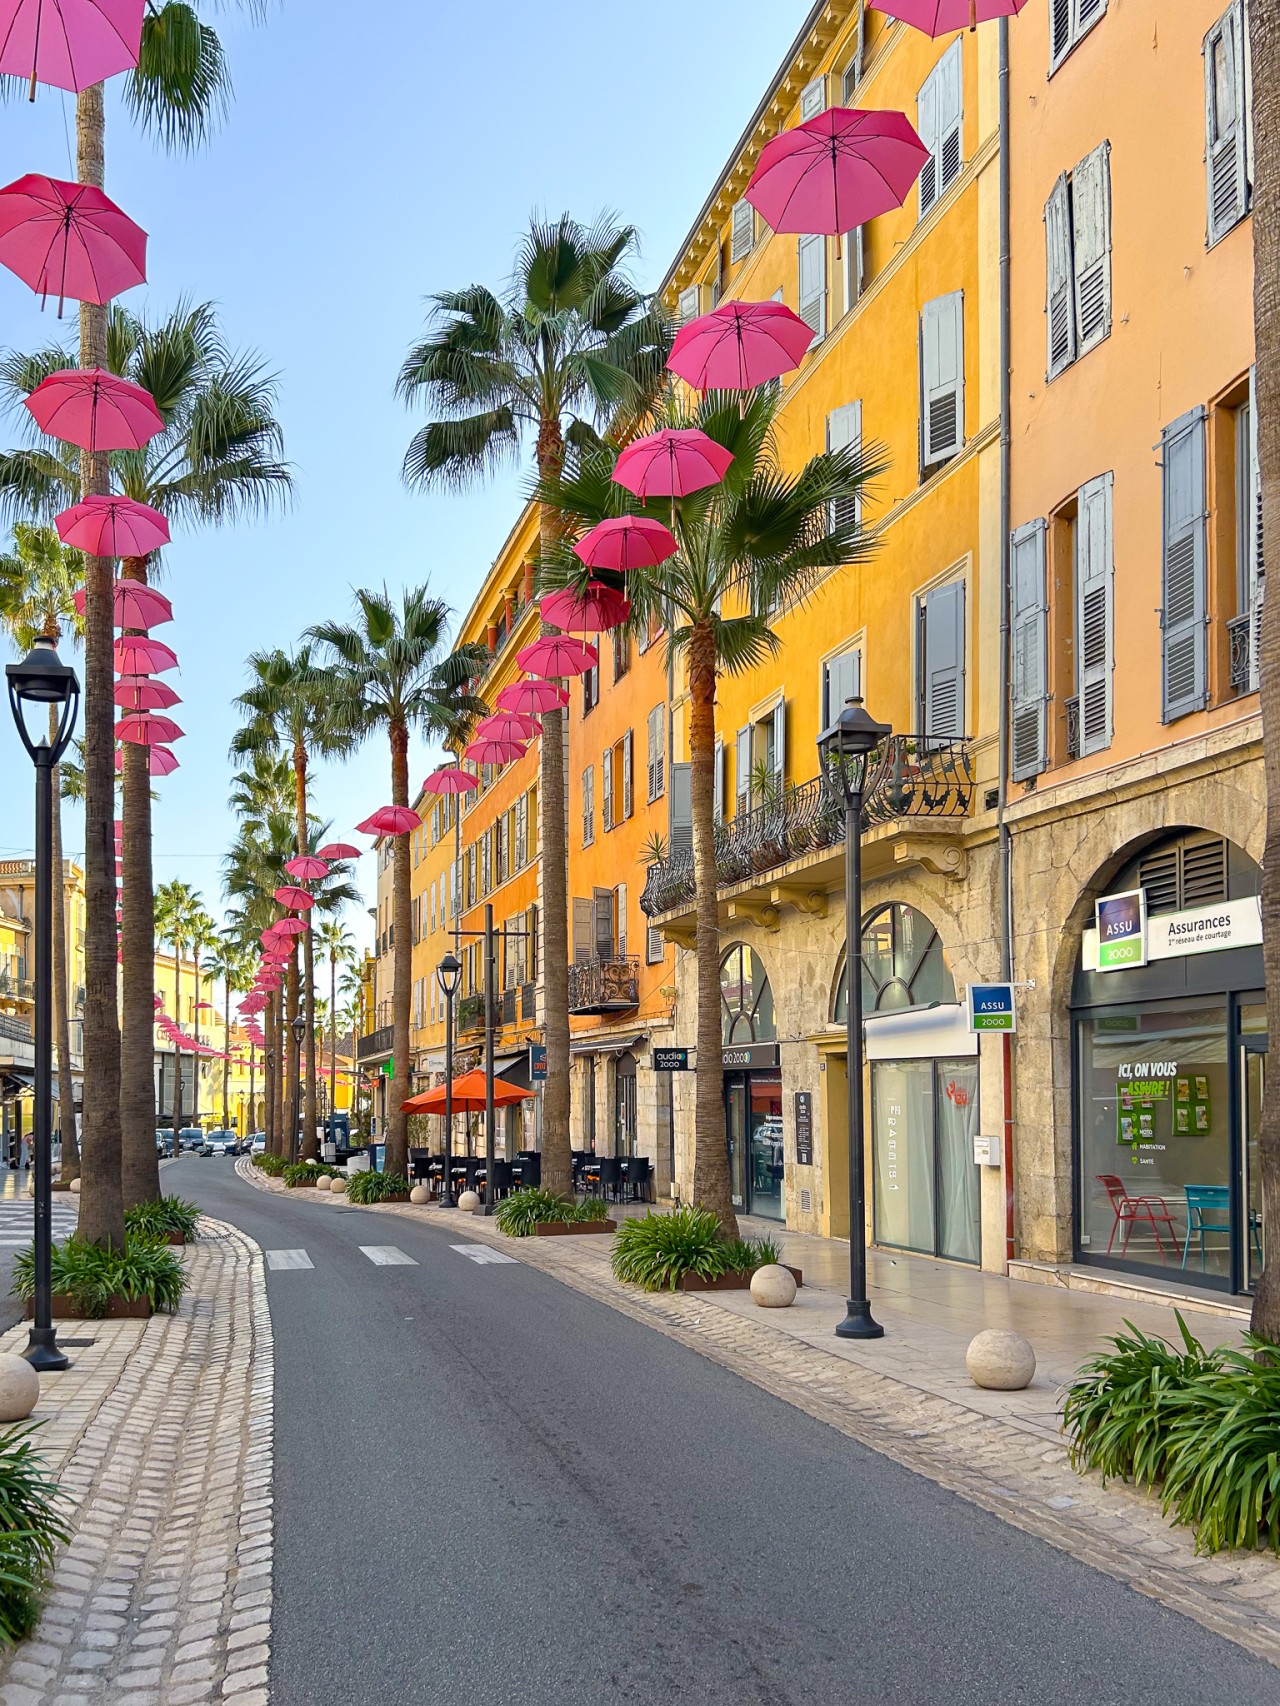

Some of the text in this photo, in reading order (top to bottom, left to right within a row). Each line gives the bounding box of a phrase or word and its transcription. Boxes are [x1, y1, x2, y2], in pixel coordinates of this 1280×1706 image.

[1106, 920, 1133, 936] ASSU
[1168, 915, 1231, 936] Assurances
[1175, 936, 1195, 945] réseau
[1196, 933, 1204, 942] de
[1205, 930, 1232, 941] courtage
[1107, 947, 1134, 961] 2000
[980, 1001, 1005, 1010] ASSU
[981, 1018, 1005, 1026] 2000
[656, 1052, 682, 1061] audio
[1117, 1061, 1178, 1080] ICI, ON VOUS
[1127, 1081, 1165, 1096] ASSURE
